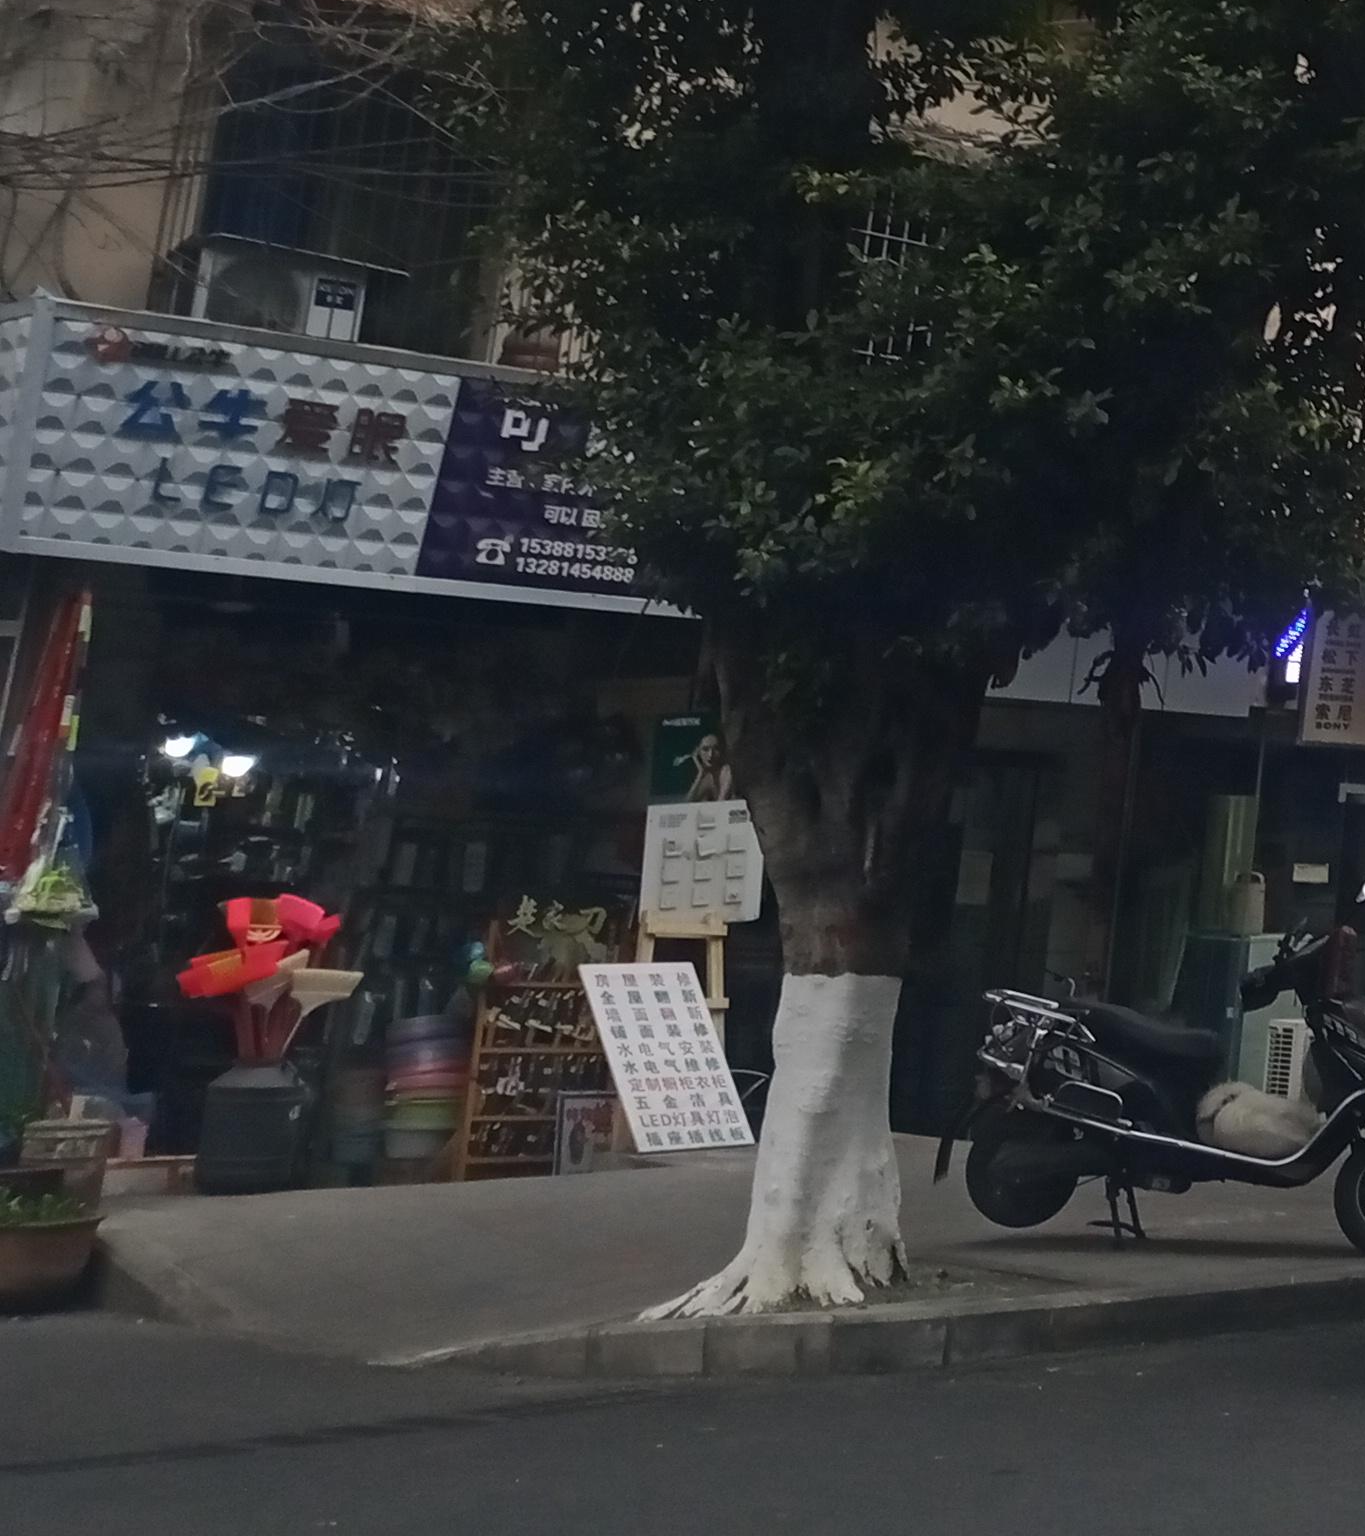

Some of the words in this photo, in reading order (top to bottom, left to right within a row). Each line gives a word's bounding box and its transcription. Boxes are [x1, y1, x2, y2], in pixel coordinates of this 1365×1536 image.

[518, 537, 638, 565] 153881536
[515, 556, 635, 584] 13281454888
[616, 1040, 714, 1057] 水电气安装
[622, 1056, 720, 1075] 水电气维修
